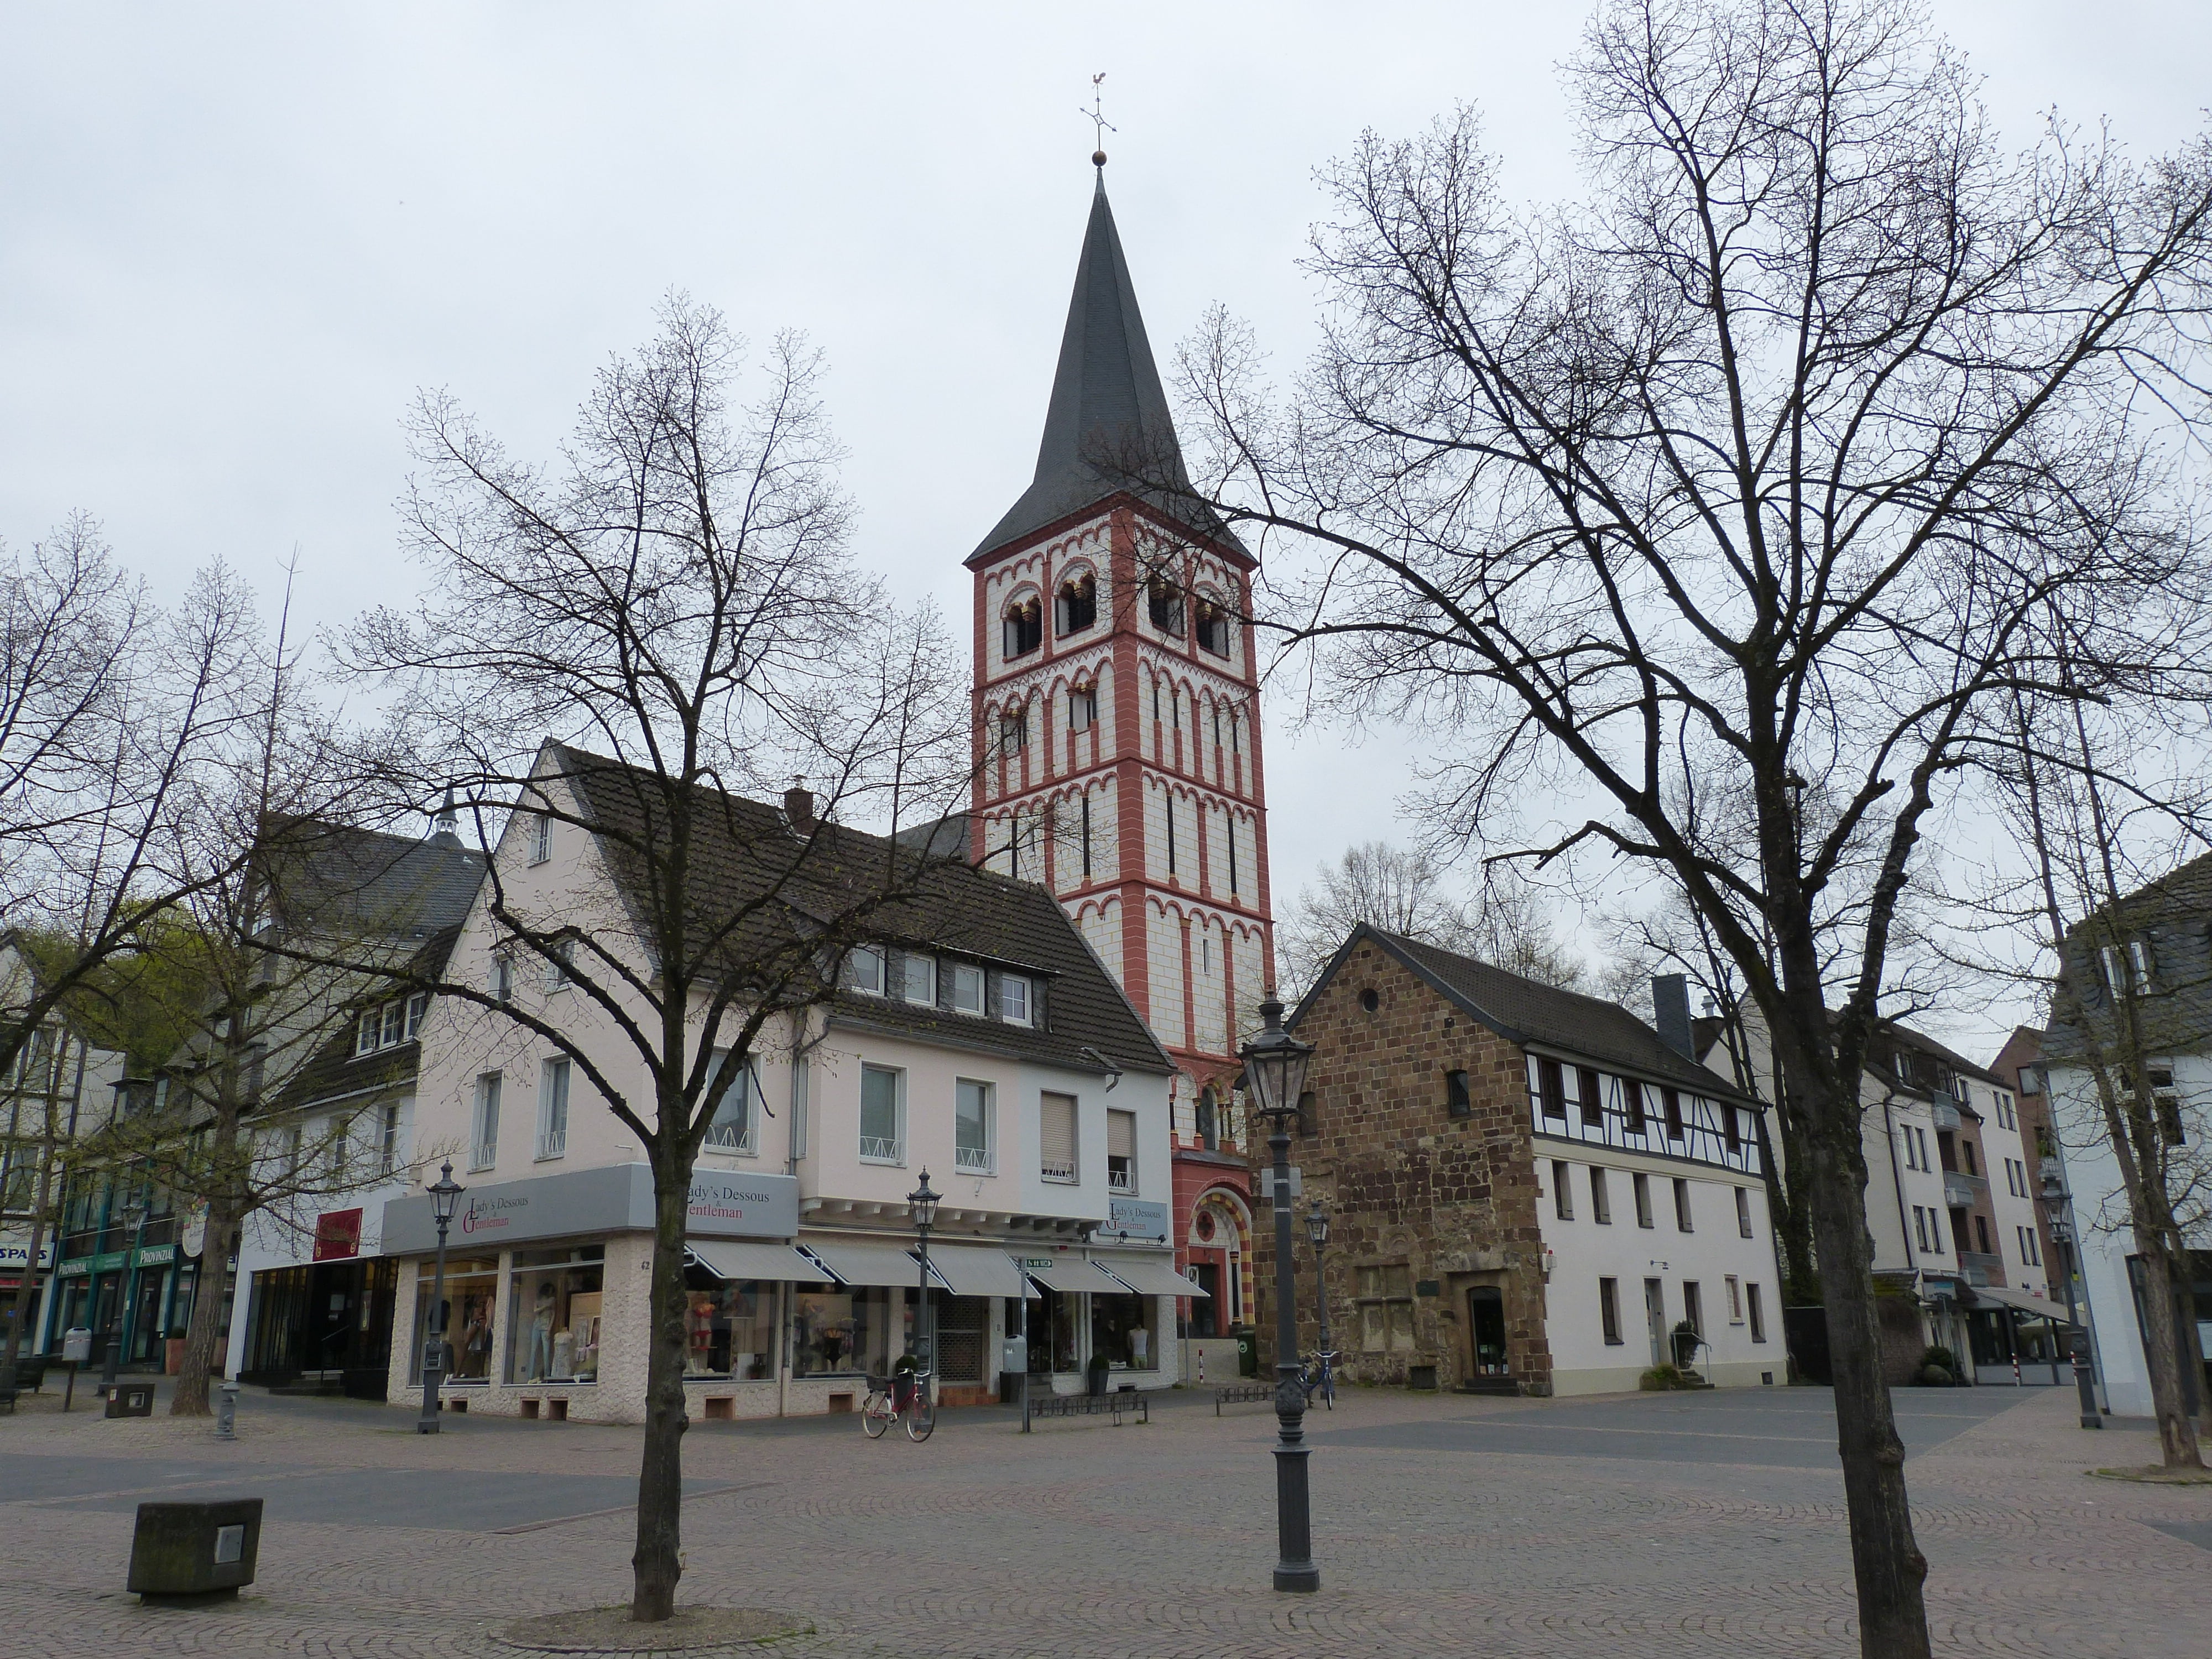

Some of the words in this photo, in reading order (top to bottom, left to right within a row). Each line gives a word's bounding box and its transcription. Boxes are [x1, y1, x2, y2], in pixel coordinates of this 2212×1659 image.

[688, 1185, 718, 1203] ady's
[723, 1187, 769, 1202] Dessous
[469, 1198, 495, 1220] Lady's
[497, 1197, 528, 1209] Dessous
[689, 1204, 742, 1218] entleman
[1110, 1203, 1133, 1220] Lady's
[1135, 1208, 1161, 1218] Dessous
[463, 1211, 509, 1233] Gentleman
[0, 1248, 47, 1259] SPAS
[140, 1248, 175, 1264] PROVINZIAL
[59, 1262, 87, 1276] PROVINZIAL
